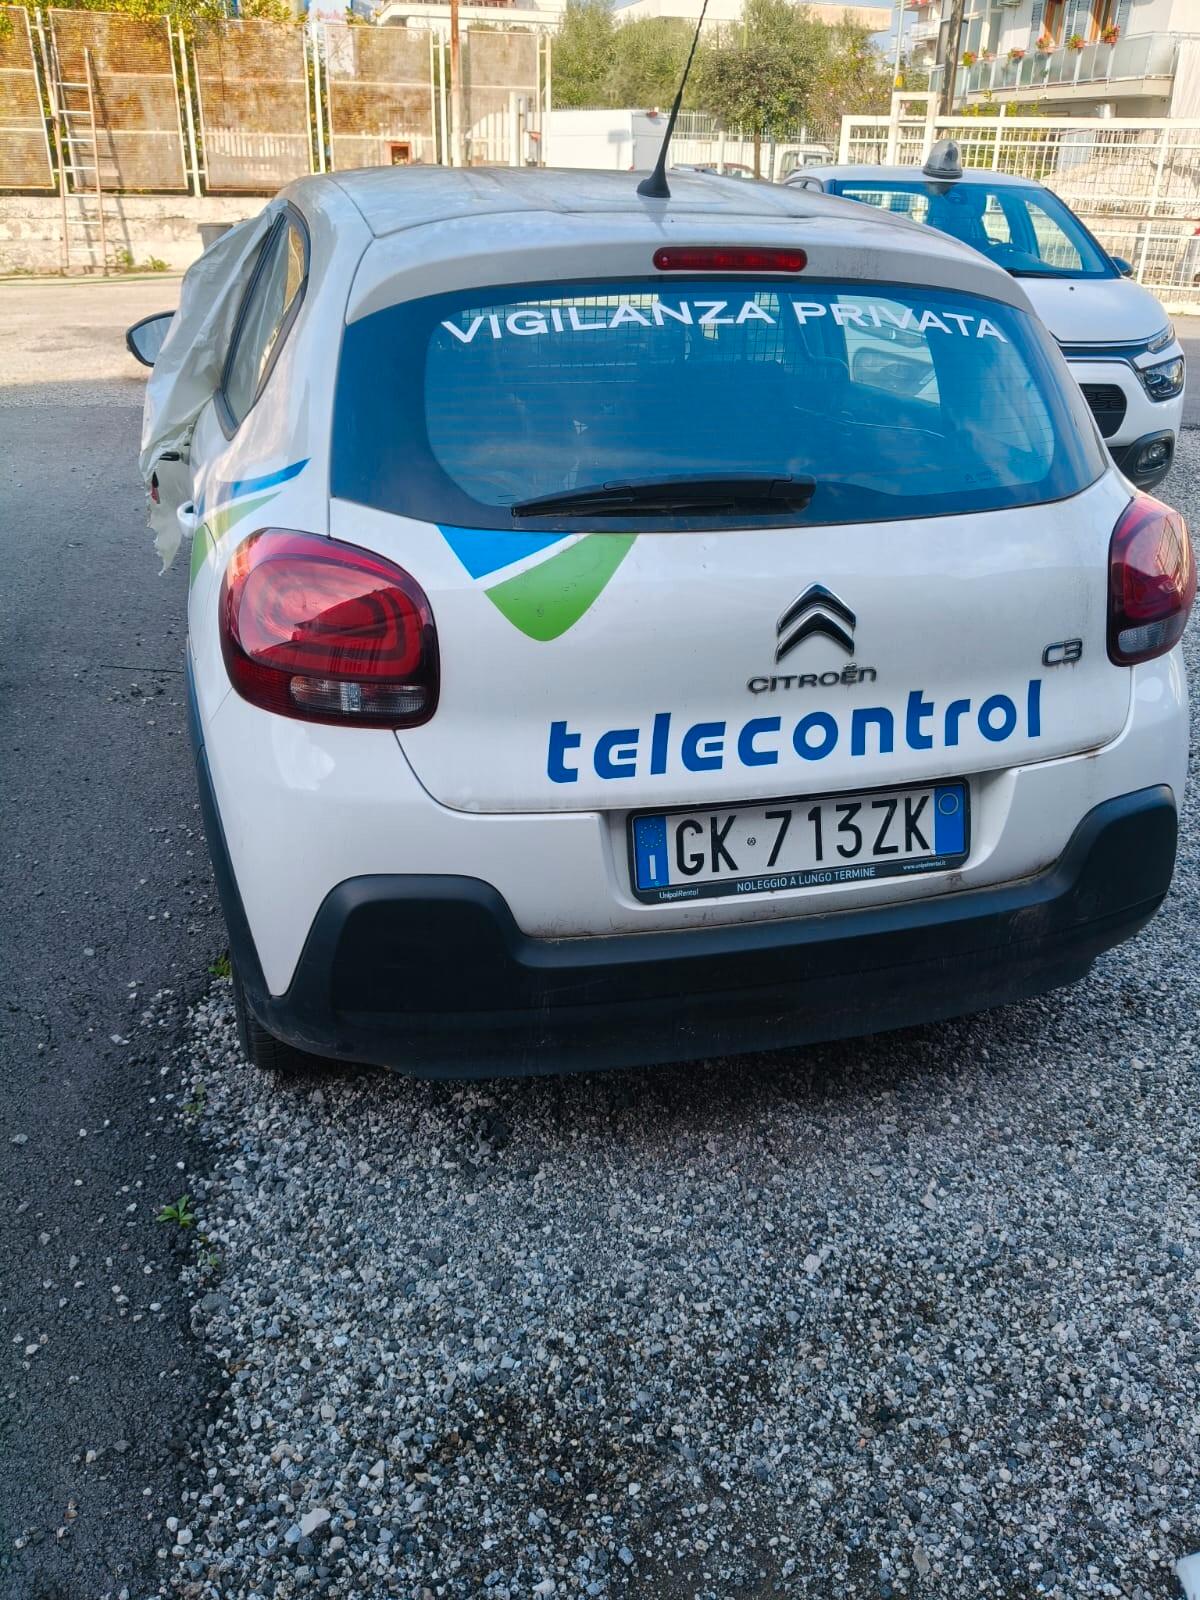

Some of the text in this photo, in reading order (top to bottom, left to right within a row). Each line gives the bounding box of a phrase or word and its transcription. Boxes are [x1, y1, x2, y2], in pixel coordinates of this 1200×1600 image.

[441, 300, 1009, 344] VIGILANZA PRIVATA
[1041, 639, 1083, 668] C3
[546, 679, 1042, 784] telecontrol
[675, 795, 931, 877] GK 713ZK
[736, 866, 876, 893] NOLEGGIO A LUNGO TERMINE
